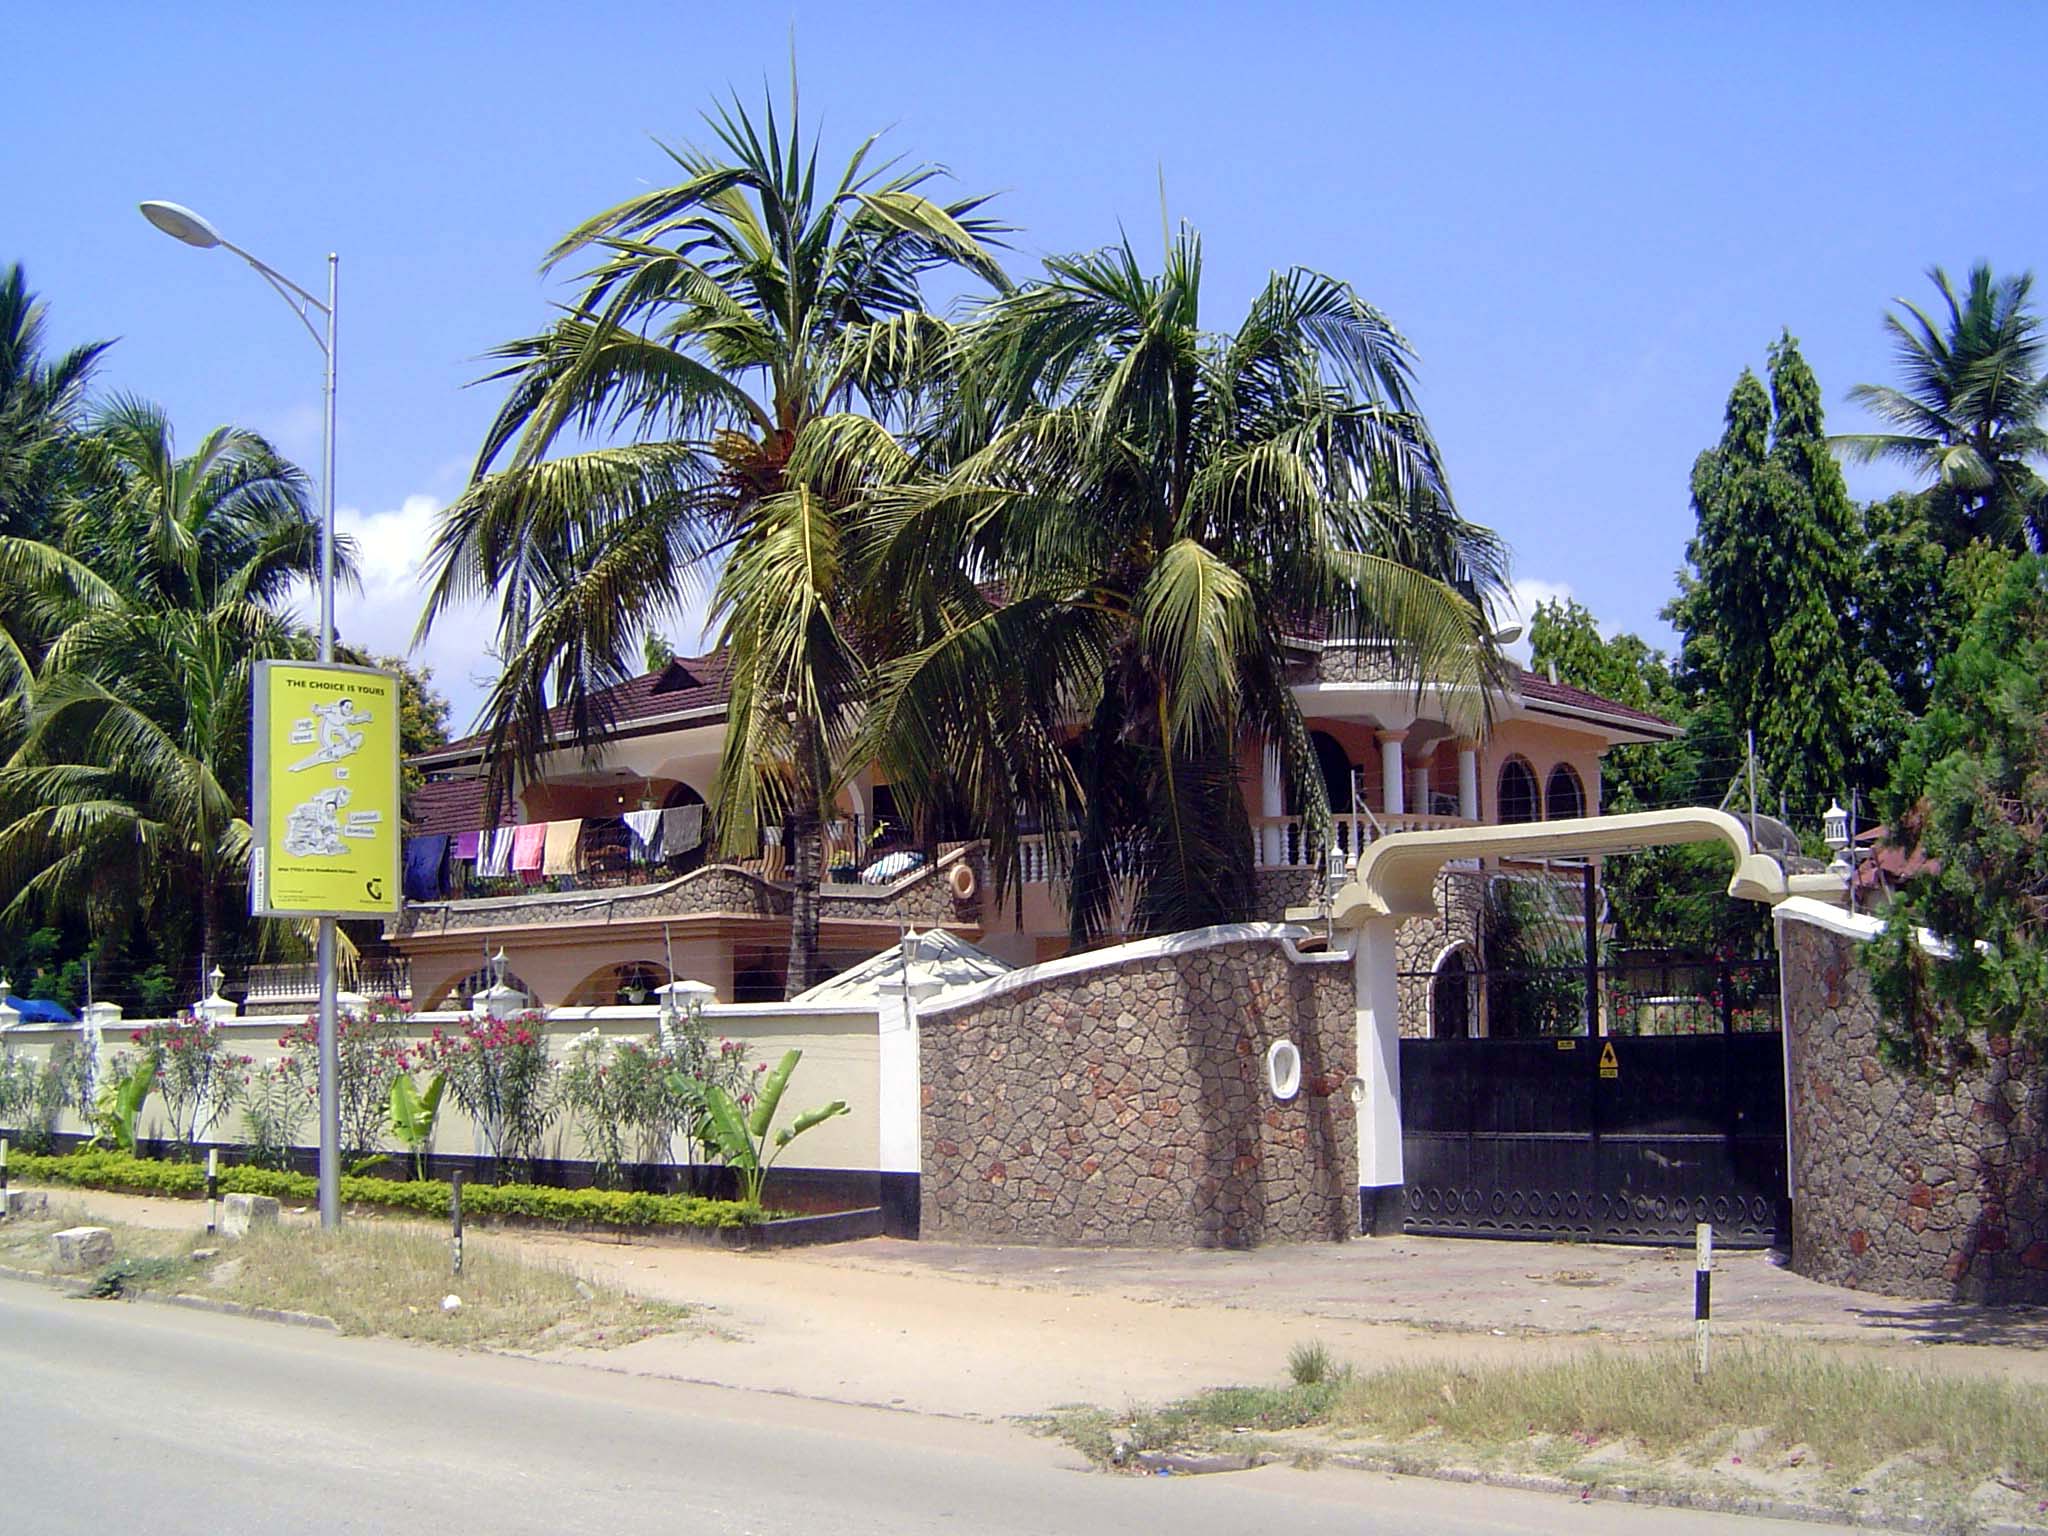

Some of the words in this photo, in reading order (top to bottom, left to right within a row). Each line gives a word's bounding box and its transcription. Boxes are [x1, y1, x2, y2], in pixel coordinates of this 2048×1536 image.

[286, 679, 306, 688] THE
[309, 681, 345, 692] CHOICE
[347, 685, 356, 693] IS
[358, 686, 385, 696] YOURS
